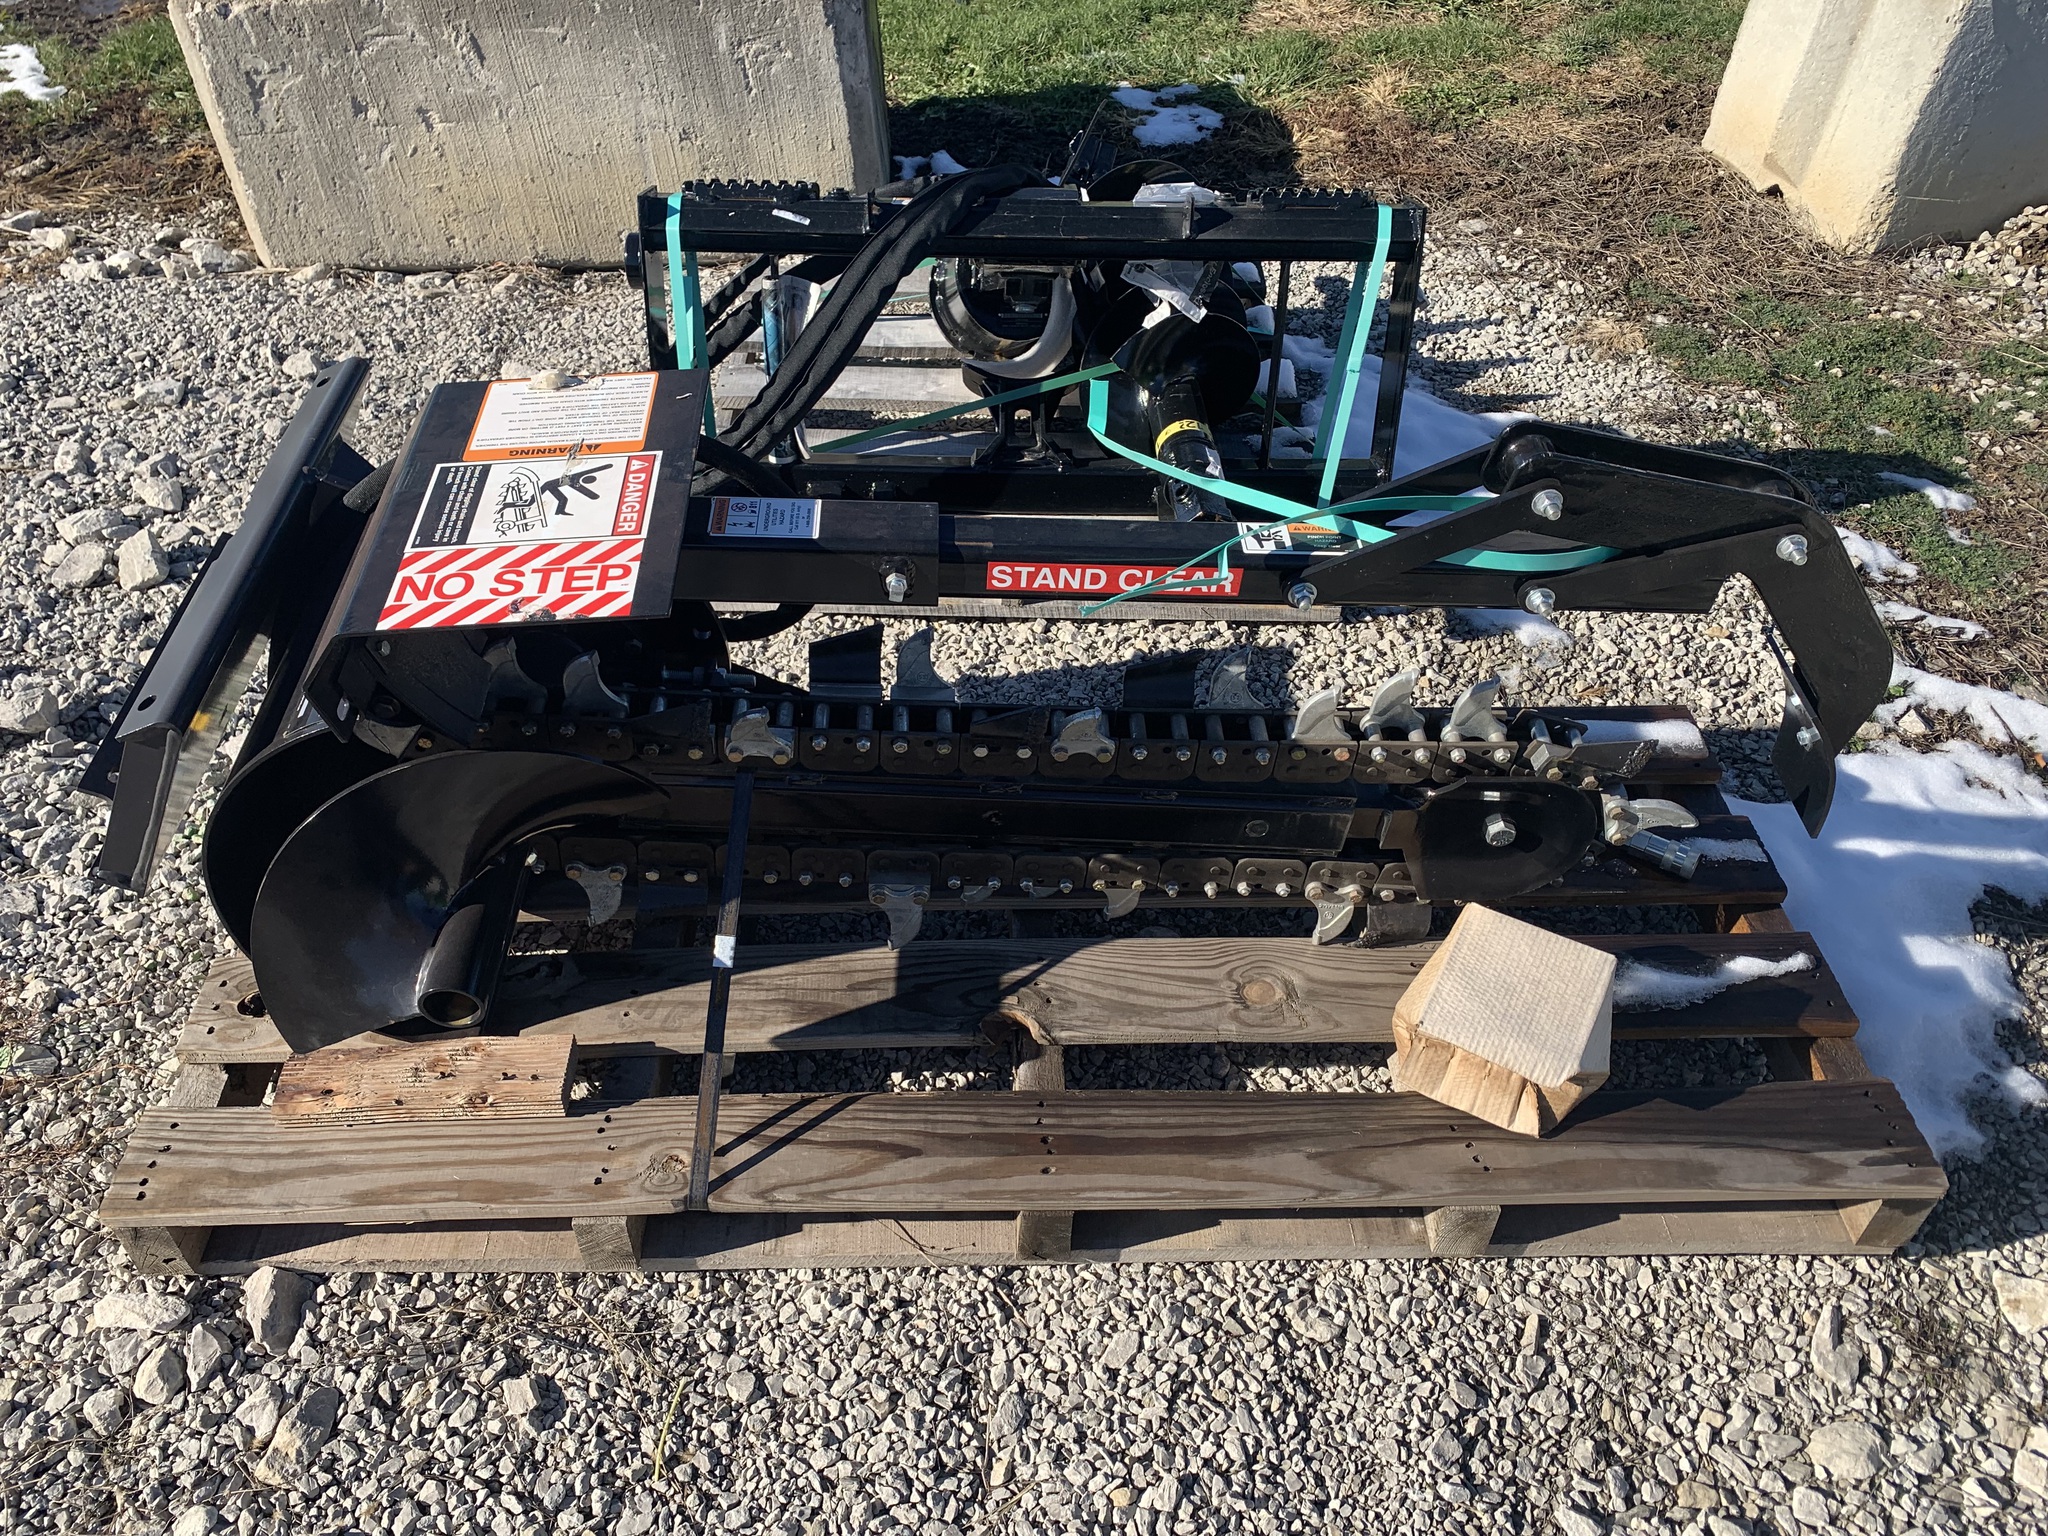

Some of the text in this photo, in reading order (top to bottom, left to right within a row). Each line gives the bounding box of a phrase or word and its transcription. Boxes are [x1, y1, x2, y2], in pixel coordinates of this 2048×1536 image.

[616, 474, 645, 533] DANGER
[393, 564, 632, 602] NO STEP
[991, 565, 1107, 590] STAND
